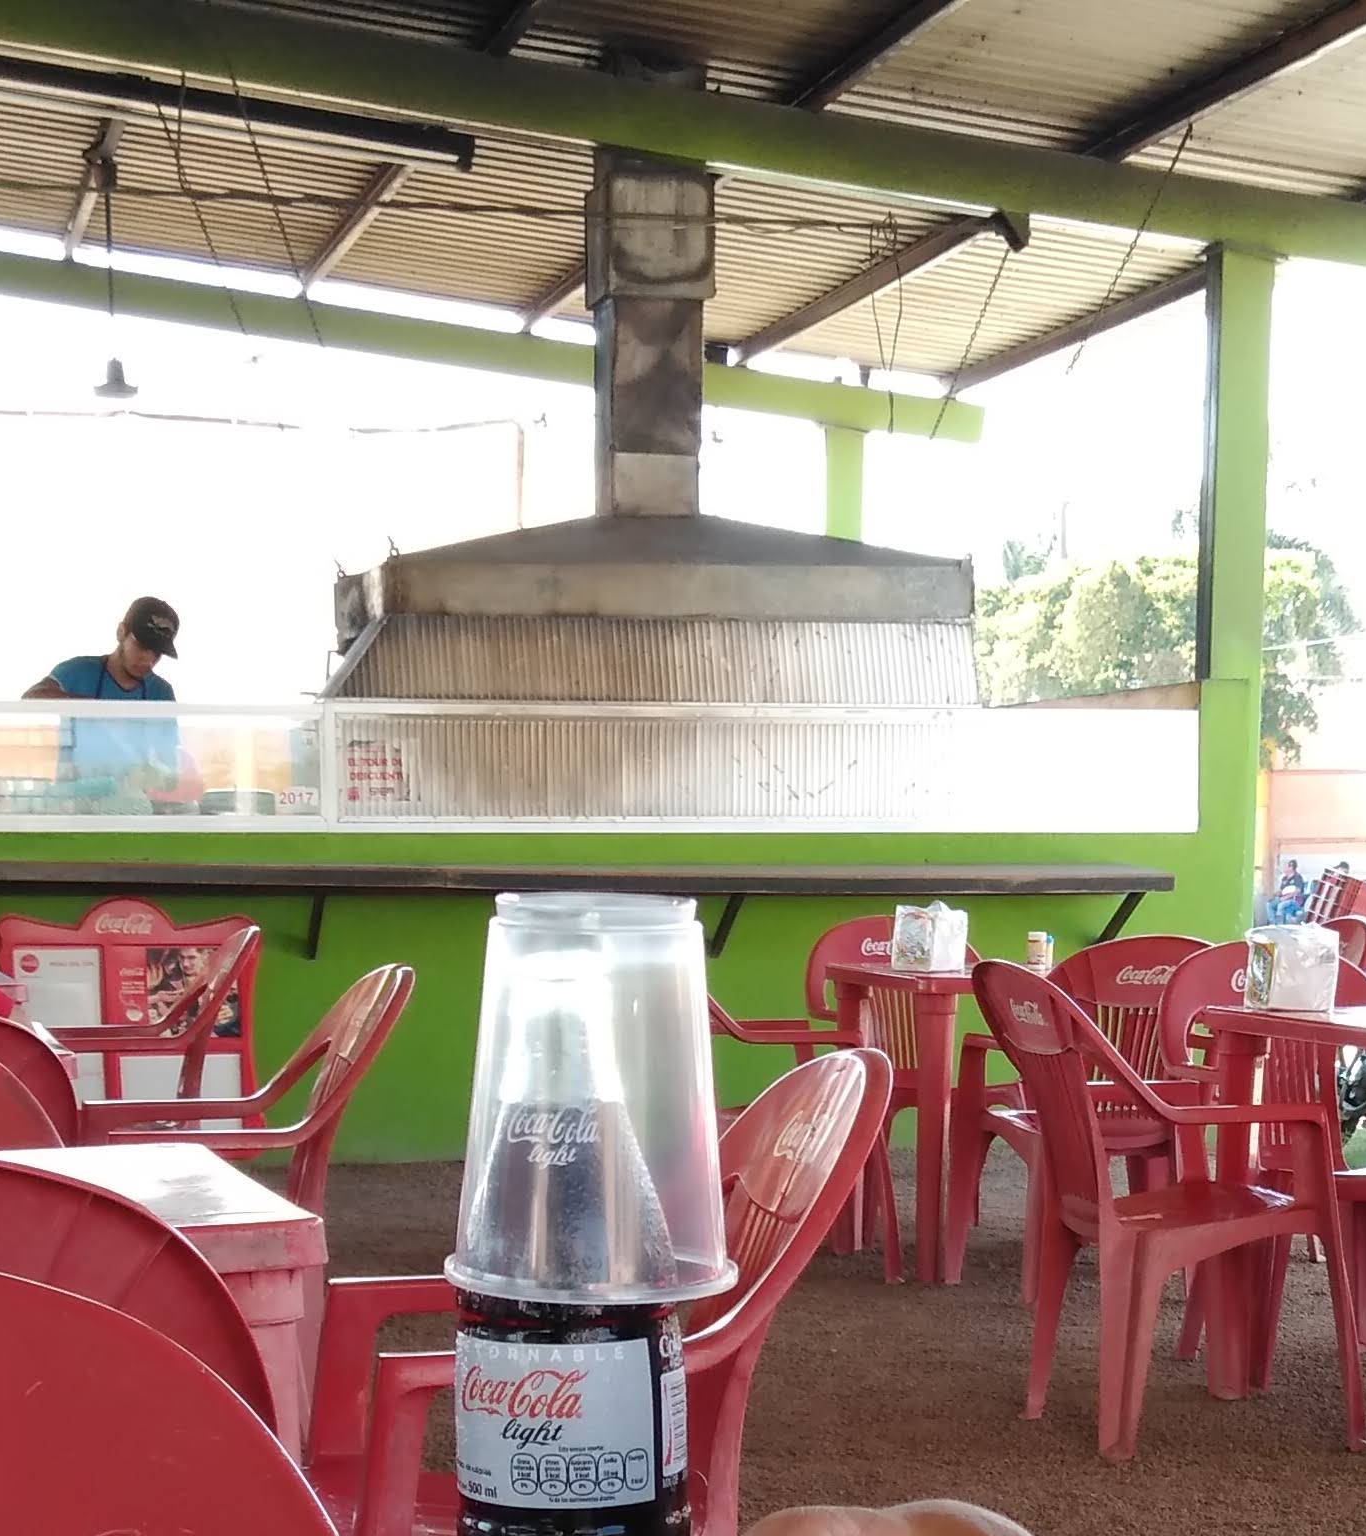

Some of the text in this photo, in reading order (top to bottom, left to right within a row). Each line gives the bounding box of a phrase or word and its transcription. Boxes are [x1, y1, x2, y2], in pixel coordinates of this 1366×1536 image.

[279, 791, 314, 806] 2017
[95, 913, 154, 935] Coca-Cola
[1115, 965, 1177, 985] Coca-Col
[507, 1102, 600, 1144] Coca-Cola
[527, 1144, 576, 1169] light
[462, 1366, 589, 1420] Coca-Cola
[501, 1418, 563, 1449] light
[468, 1480, 482, 1496] 500
[484, 1486, 497, 1499] ml
